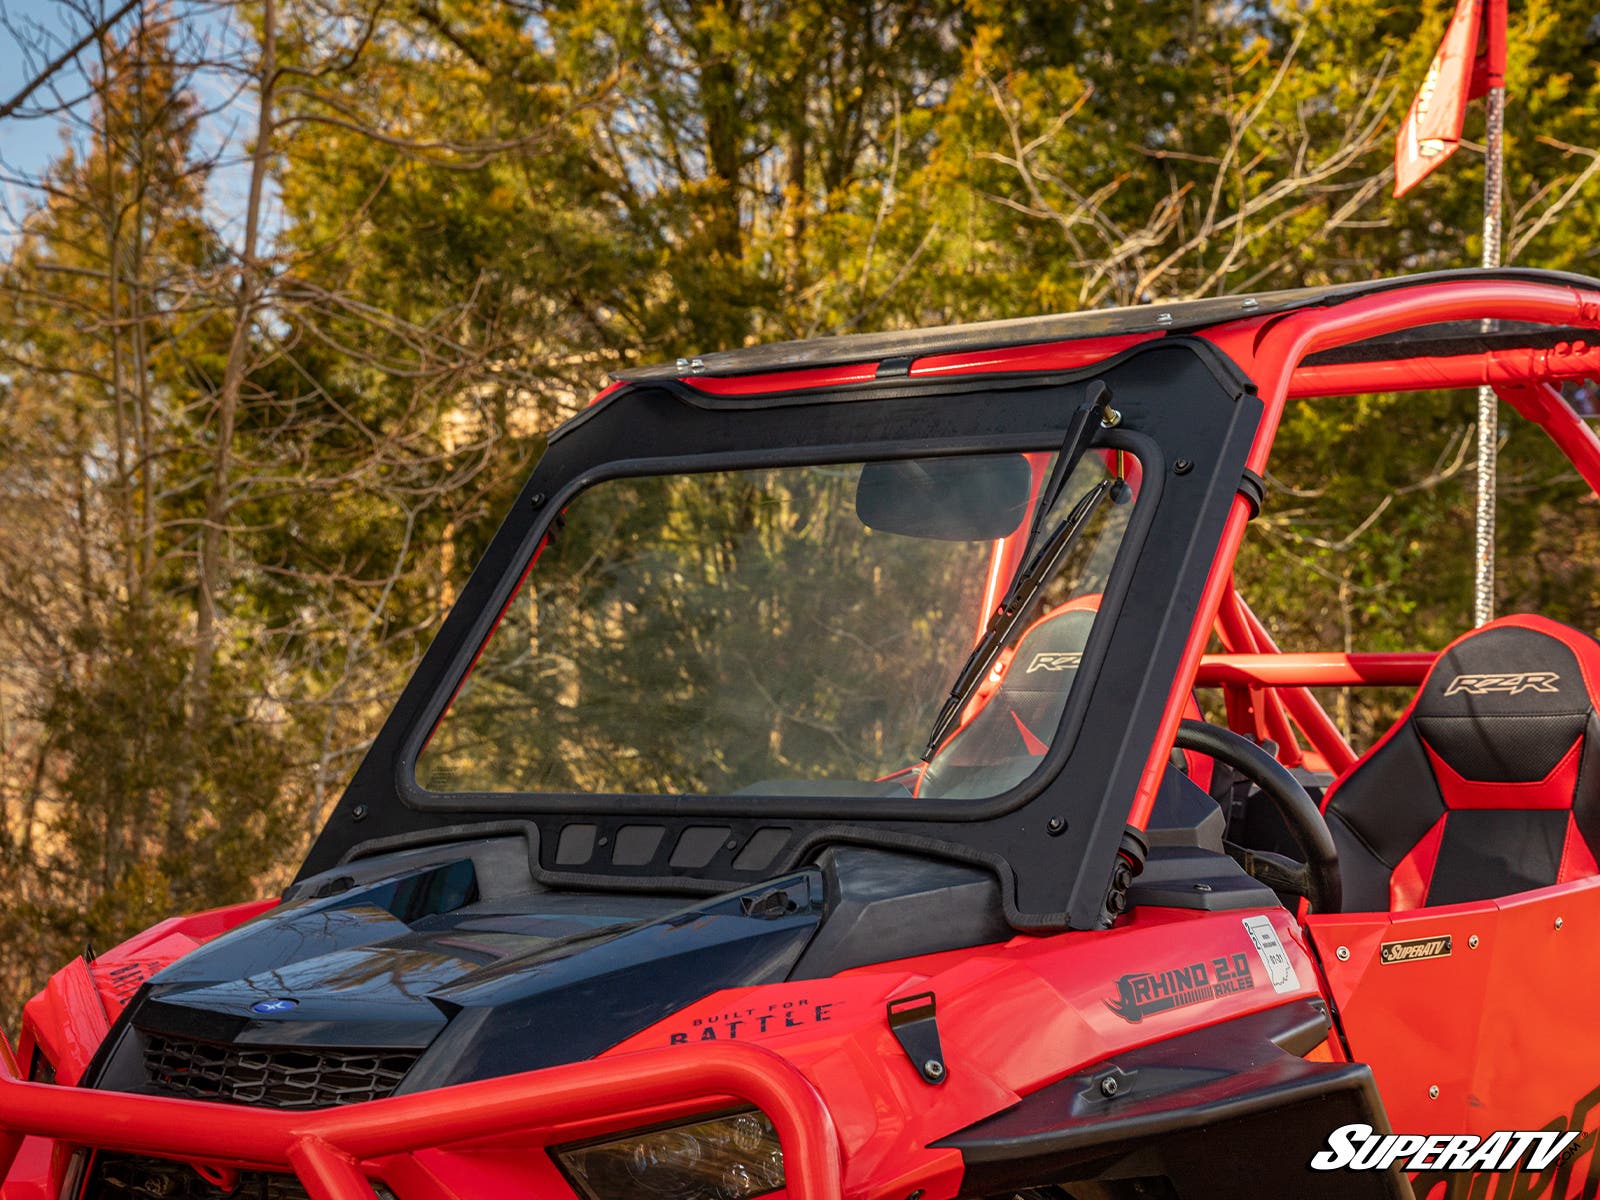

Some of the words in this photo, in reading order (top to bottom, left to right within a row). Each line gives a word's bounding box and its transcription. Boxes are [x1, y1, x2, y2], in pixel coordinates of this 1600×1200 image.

[1026, 652, 1083, 673] RZ
[1444, 672, 1560, 696] RZR
[1387, 940, 1446, 961] SUPERATV
[1130, 962, 1210, 1003] RHINO
[1212, 952, 1250, 982] 2.0
[1214, 975, 1254, 1000] AXLES
[669, 1003, 833, 1046] BATTLE
[693, 1008, 757, 1027] BUILT
[768, 999, 809, 1012] FOR
